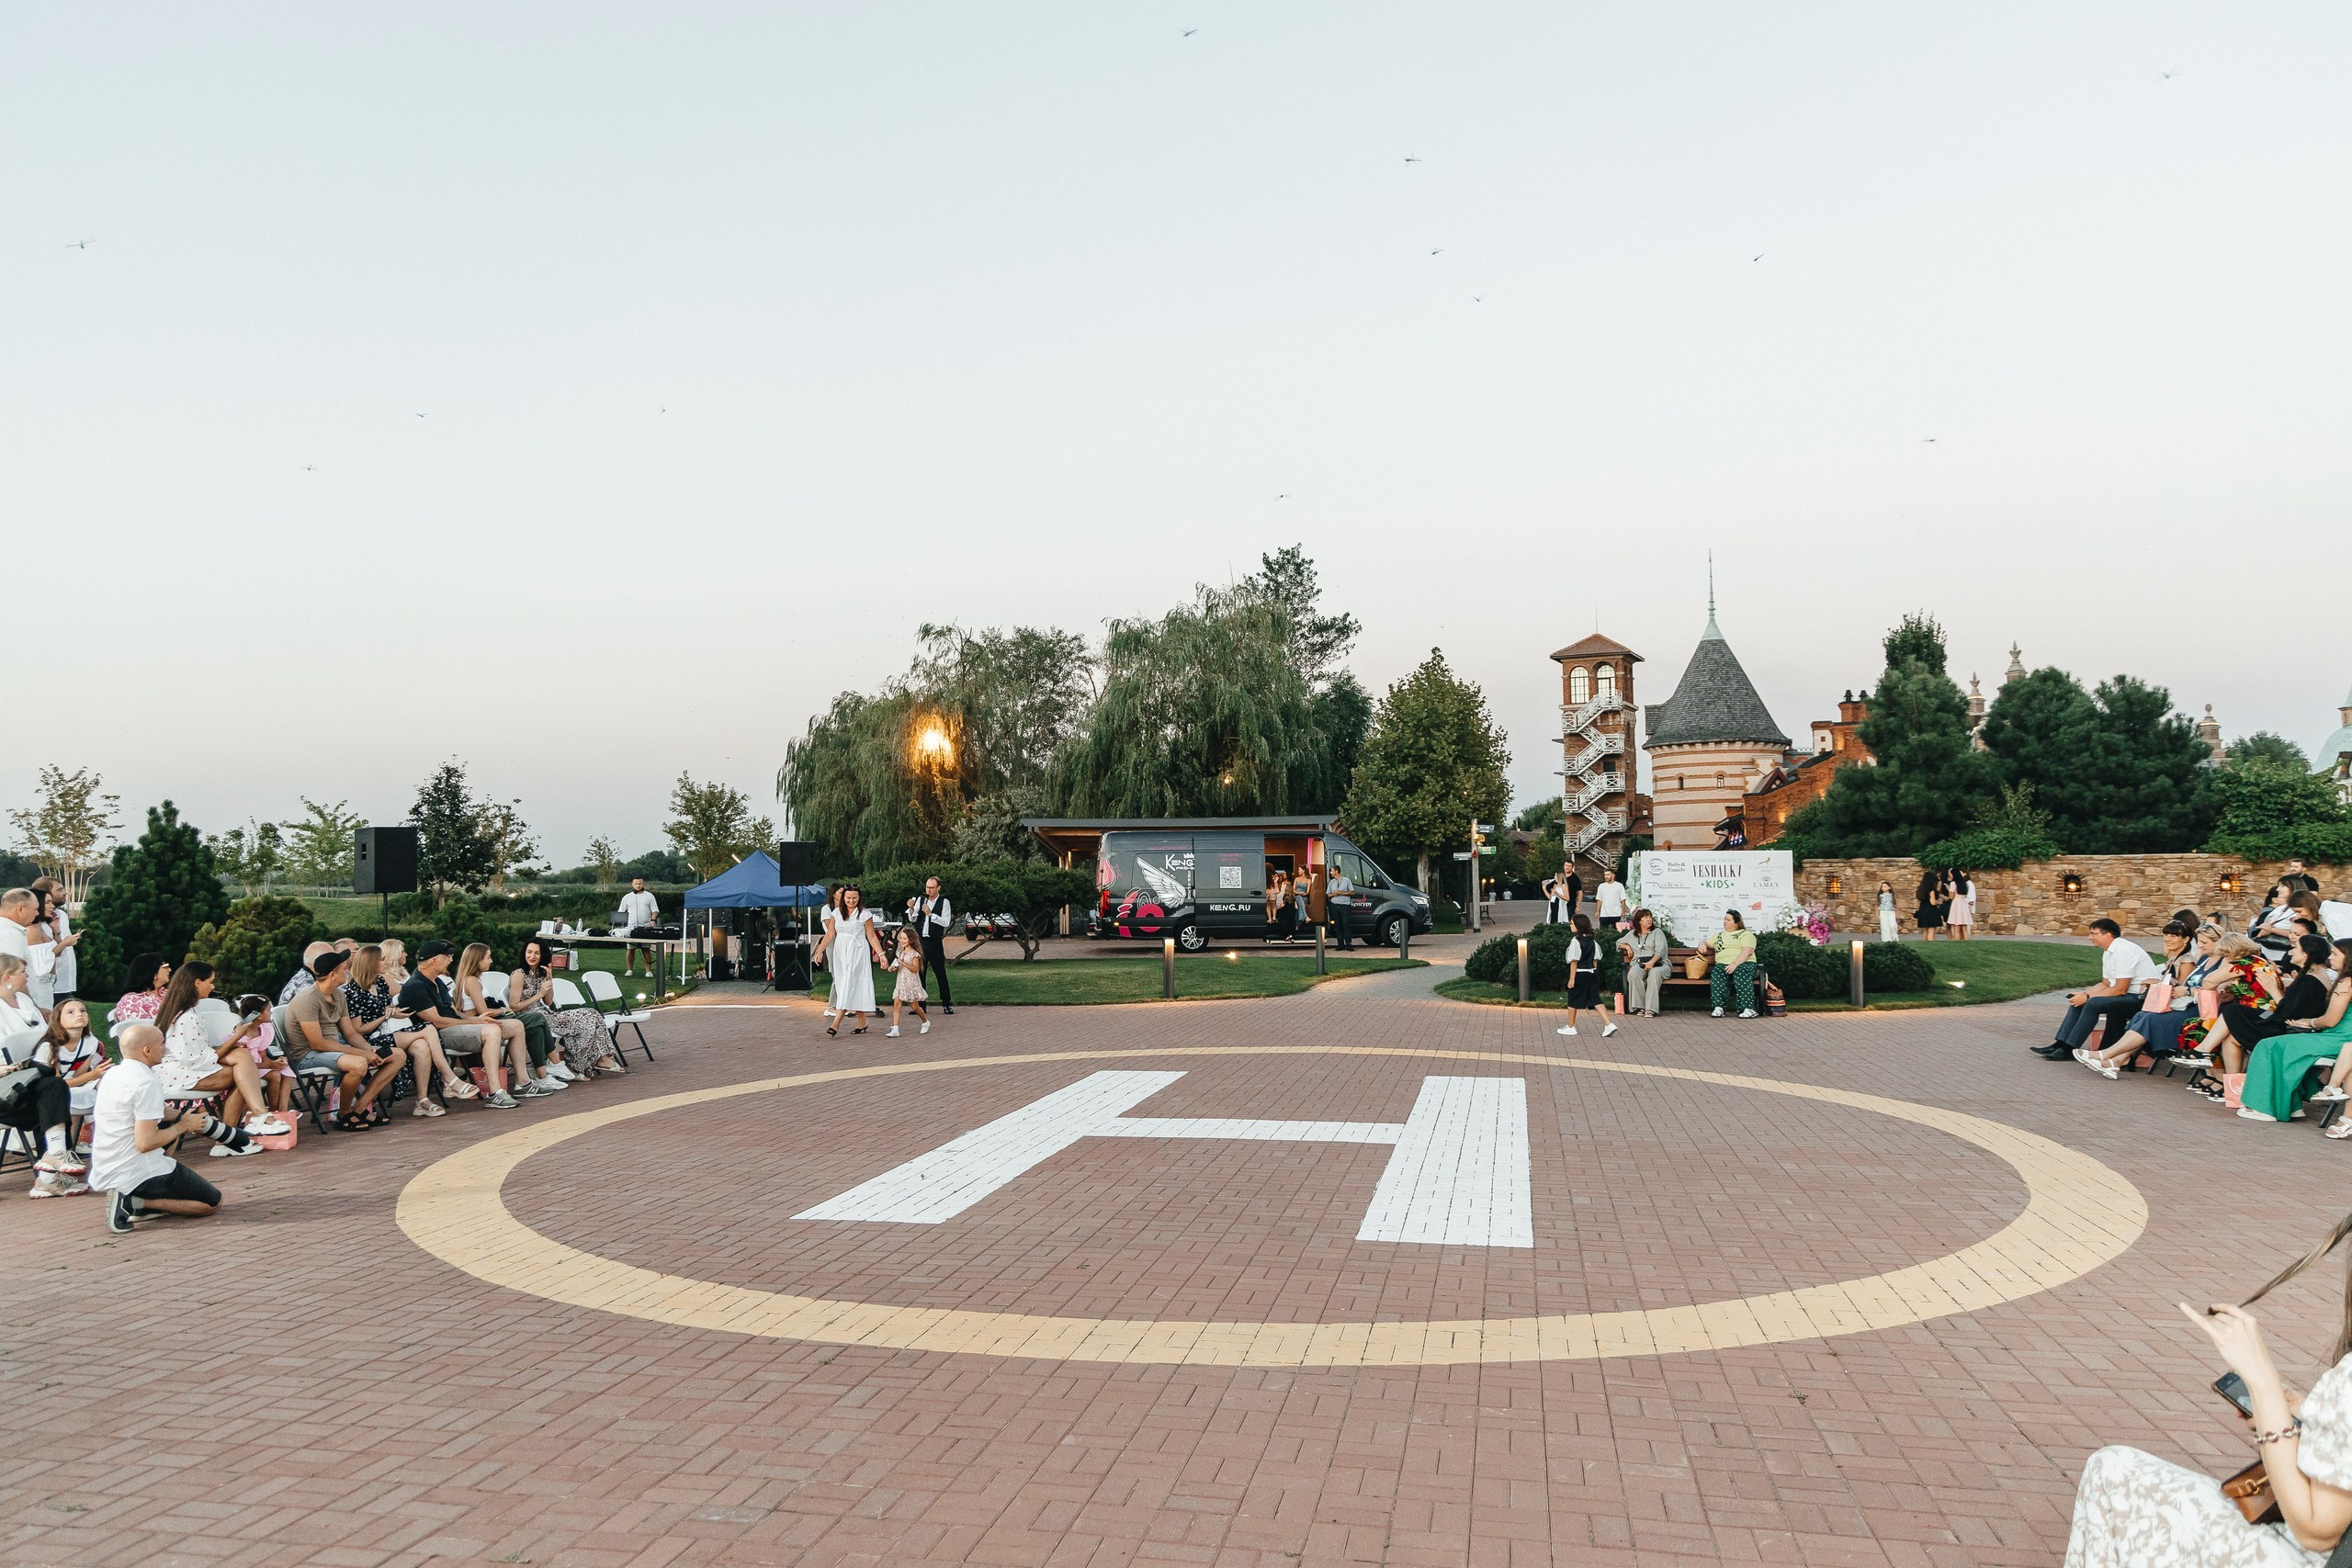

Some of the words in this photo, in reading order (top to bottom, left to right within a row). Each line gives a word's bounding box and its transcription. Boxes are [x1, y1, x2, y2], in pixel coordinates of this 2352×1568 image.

[1705, 879, 1730, 889] KIDS
[1209, 903, 1251, 912] KENG.RU
[789, 1070, 1534, 1248] H
